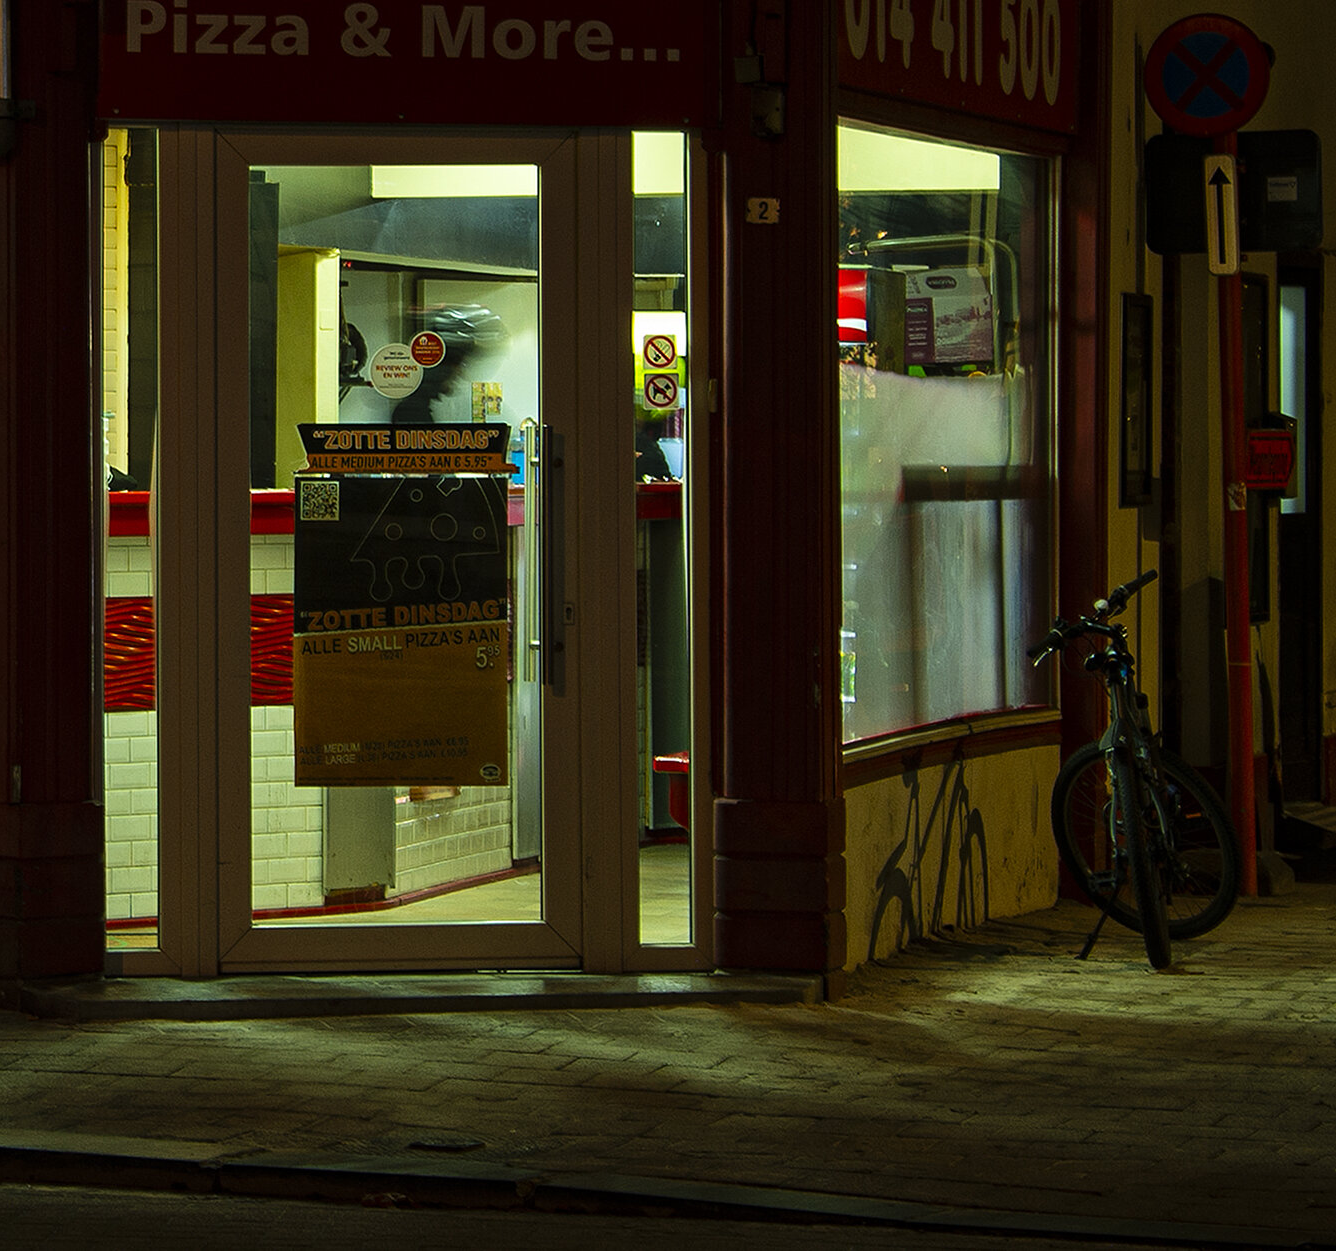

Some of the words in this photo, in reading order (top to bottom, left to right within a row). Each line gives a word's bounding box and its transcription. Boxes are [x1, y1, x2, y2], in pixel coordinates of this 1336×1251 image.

[125, 0, 310, 57] Pizza
[339, 2, 393, 60] &
[421, 5, 681, 63] More...
[845, 0, 916, 71] 014
[930, 0, 984, 87] 411
[998, 0, 1062, 107] 500
[758, 201, 769, 220] 2
[375, 364, 402, 372] REVIEW
[311, 456, 338, 469] ALLE
[340, 456, 385, 469] MEDIUM
[387, 456, 427, 469] PIZZA'S
[429, 456, 452, 469] AAN
[301, 638, 342, 655] ALLE
[347, 635, 403, 653] SMALL
[405, 630, 464, 649] PIZZA'S
[467, 627, 501, 644] AAN
[323, 742, 361, 754] MEDIUM
[324, 753, 357, 766] LARGE
